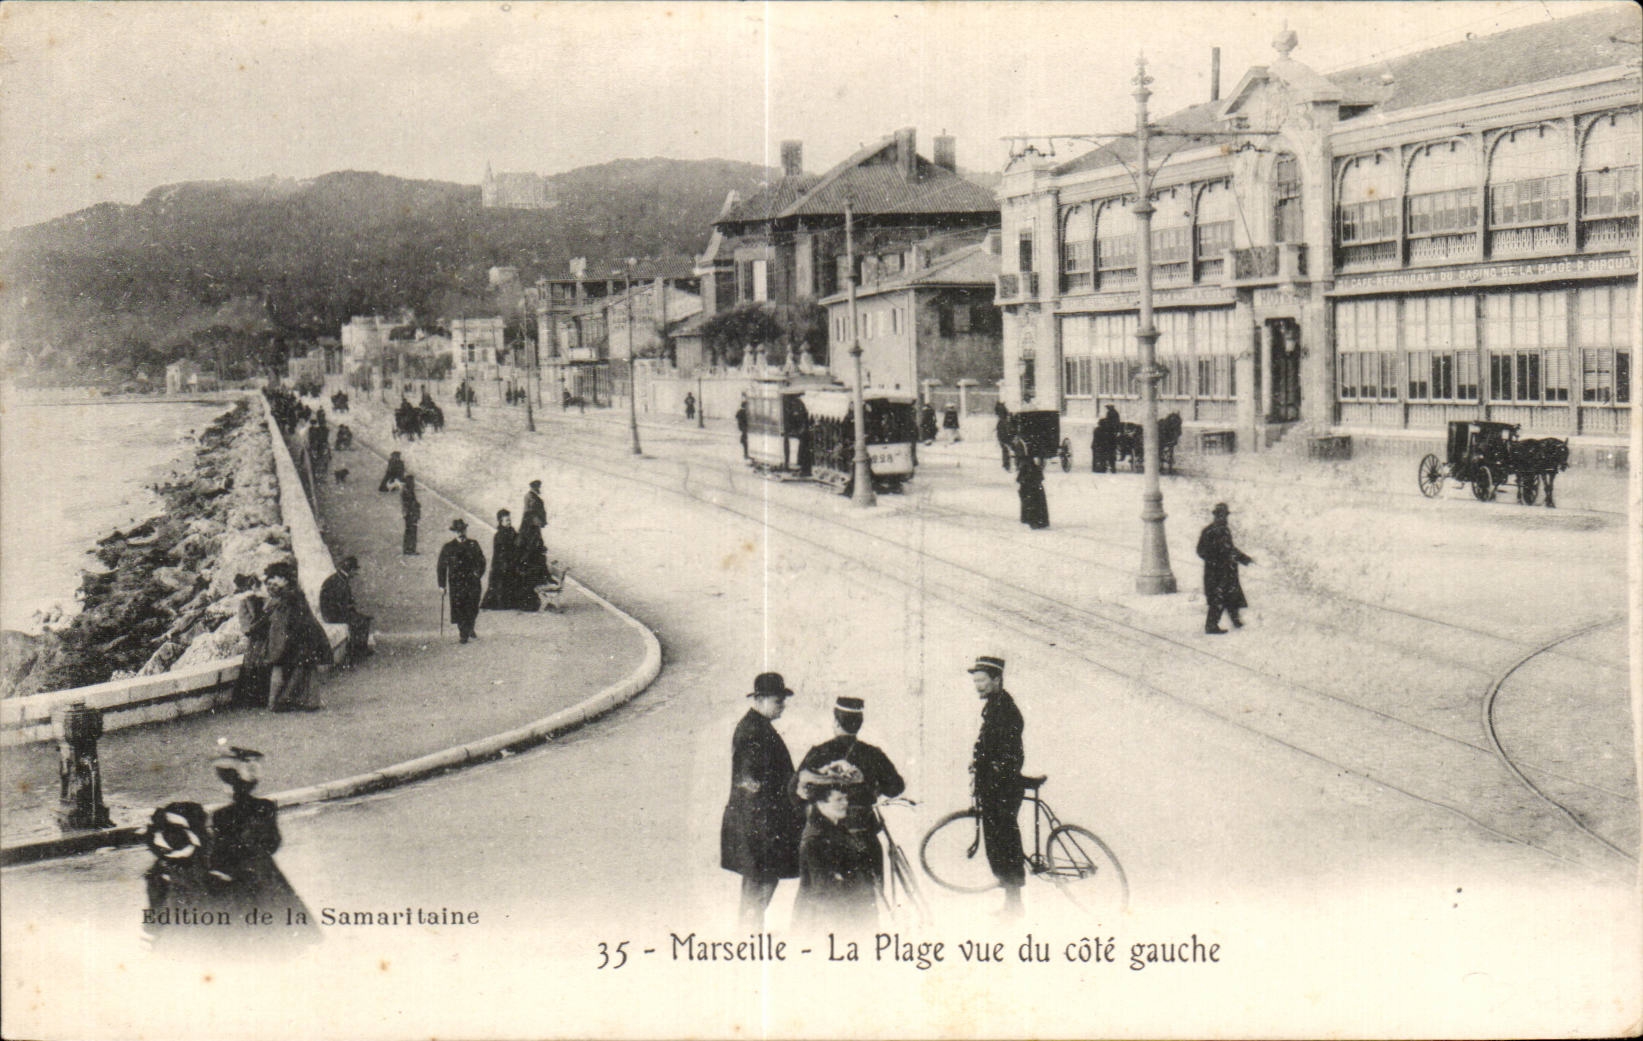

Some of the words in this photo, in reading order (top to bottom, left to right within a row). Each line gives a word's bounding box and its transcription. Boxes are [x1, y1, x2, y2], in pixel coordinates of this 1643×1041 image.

[1440, 270, 1454, 281] DU
[1459, 266, 1497, 279] CASINO
[1502, 265, 1517, 277] DE
[1520, 264, 1535, 276] LA
[1538, 261, 1572, 274] PLAGE
